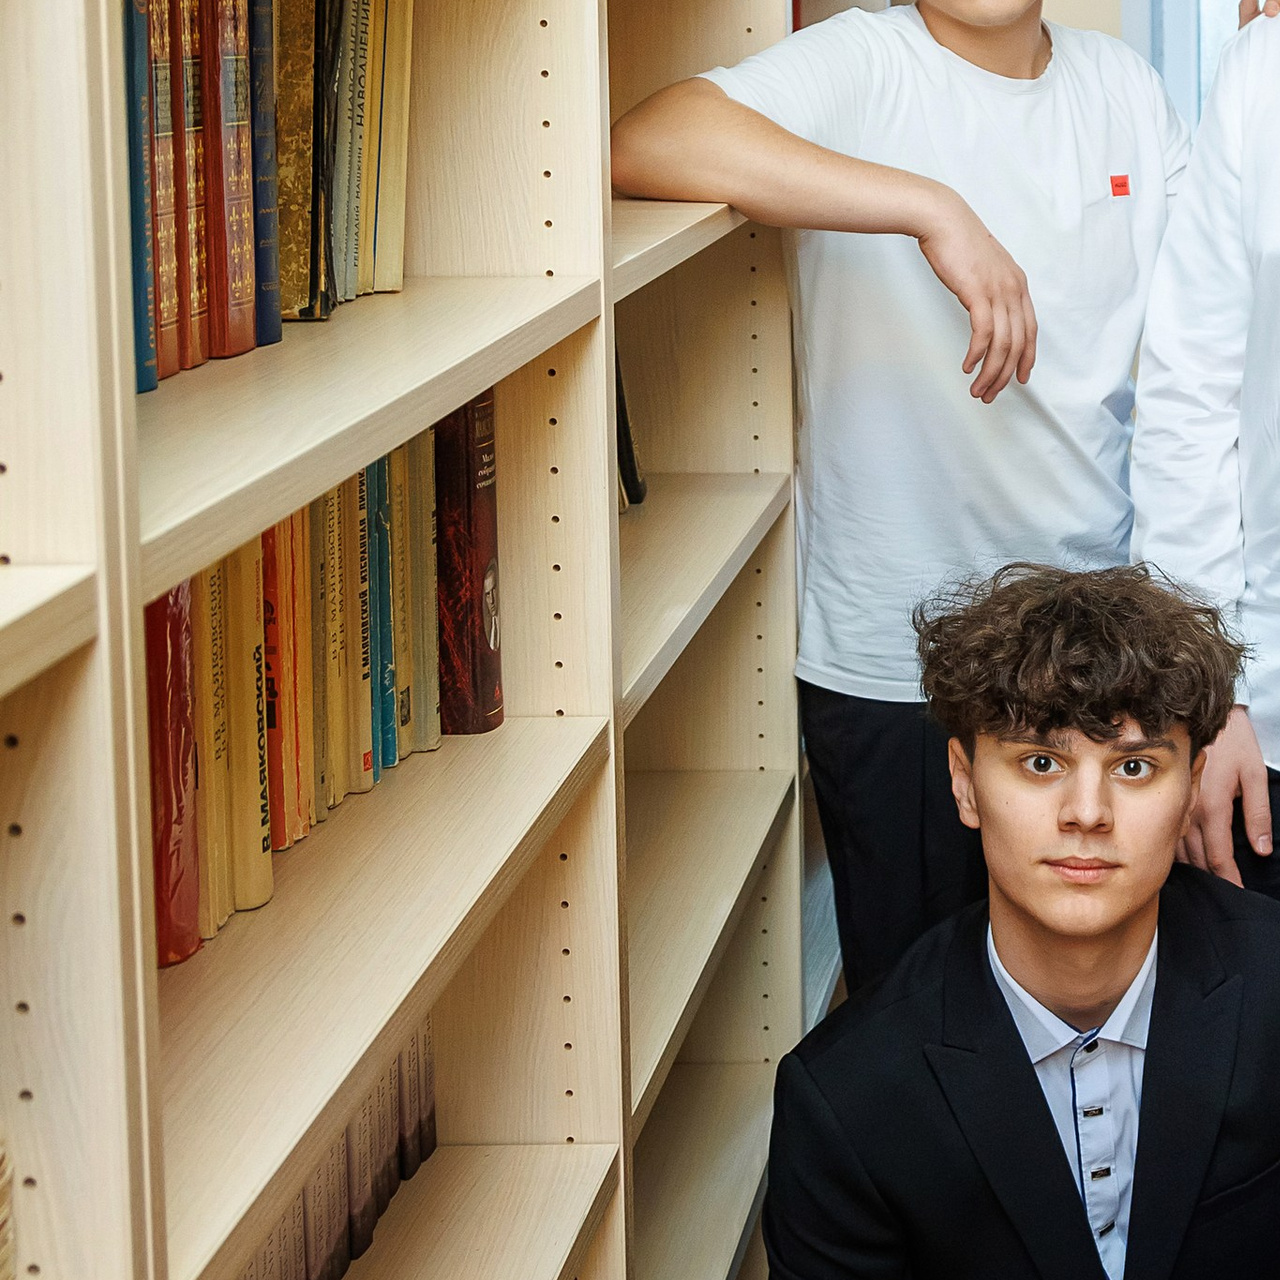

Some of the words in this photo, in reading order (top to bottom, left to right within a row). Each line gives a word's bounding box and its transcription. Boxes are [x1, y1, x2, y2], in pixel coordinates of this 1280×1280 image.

[355, 146, 363, 202] МАШКИН
[353, 204, 361, 269] ГЕННАДИЙ
[359, 517, 367, 585] ИЗБРАННАЯ
[210, 573, 221, 718] МАЯКОВСКИЙ
